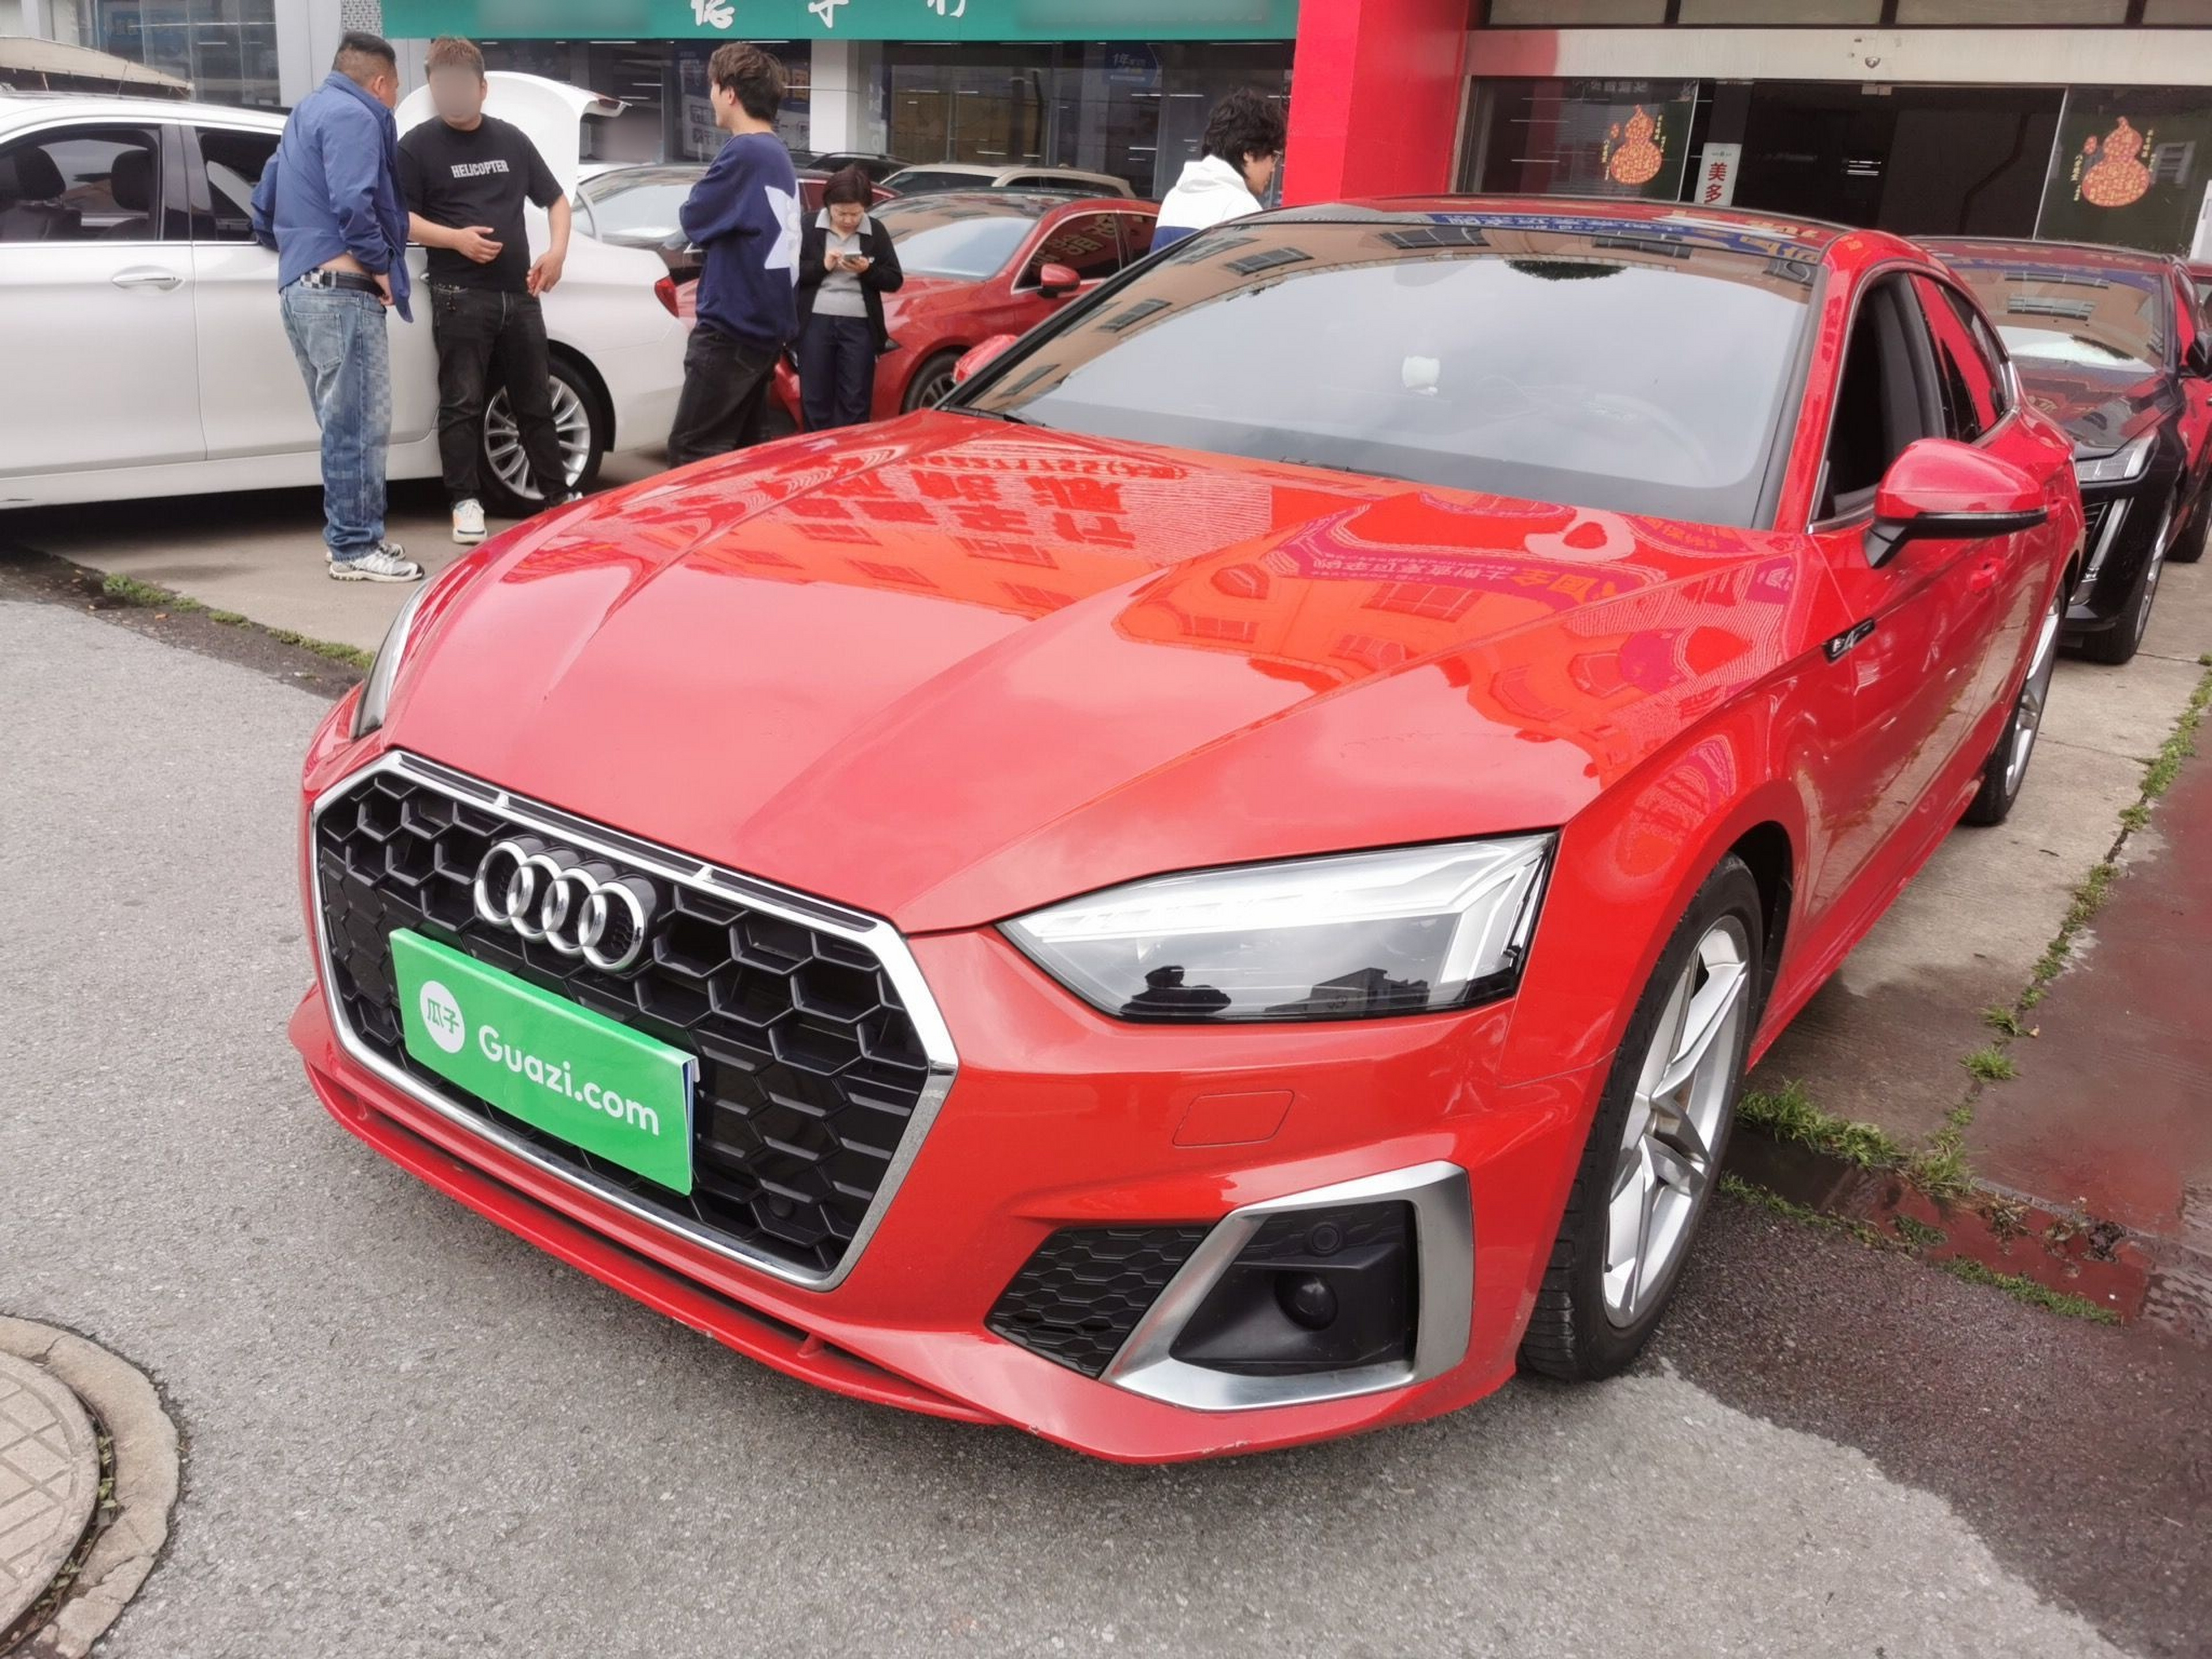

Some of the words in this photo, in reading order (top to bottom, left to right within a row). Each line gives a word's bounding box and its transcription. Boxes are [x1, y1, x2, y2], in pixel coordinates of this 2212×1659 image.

[450, 160, 509, 178] HELICOPTER
[1705, 162, 1728, 203] 美多
[427, 998, 459, 1034] 瓜子
[479, 1025, 660, 1136] Guazi.com
